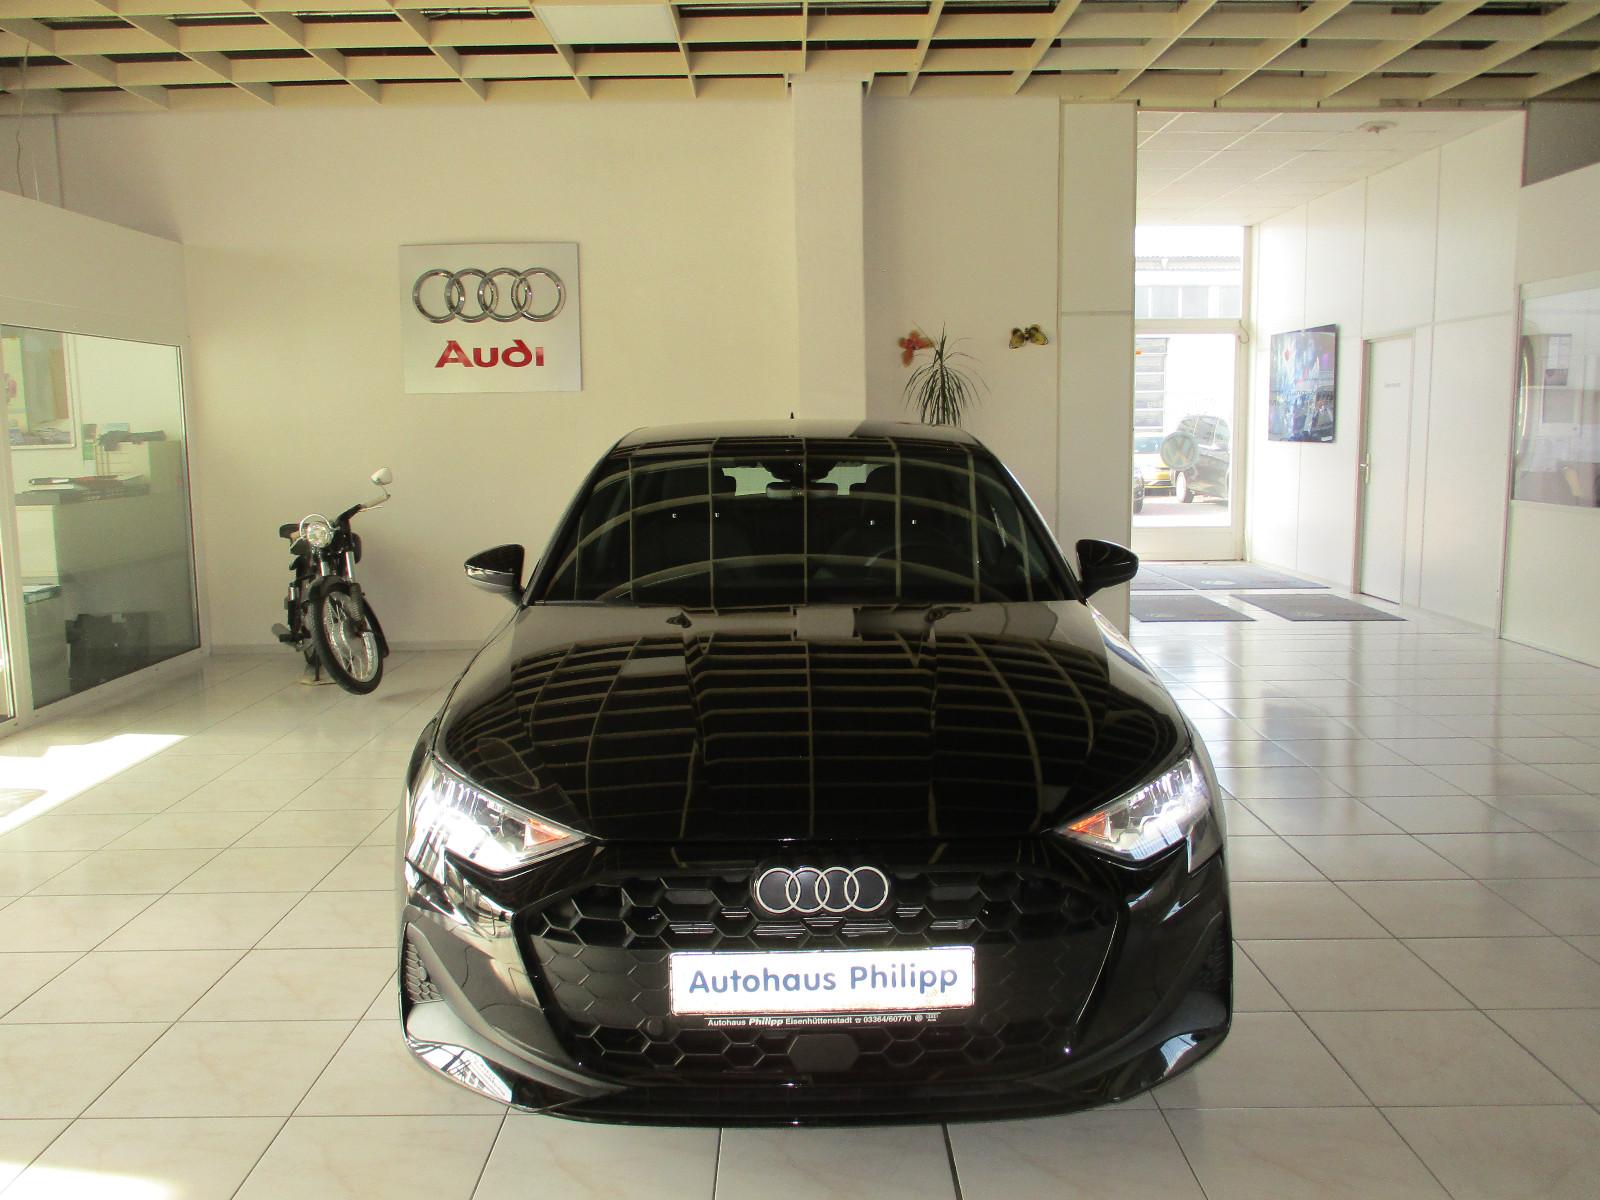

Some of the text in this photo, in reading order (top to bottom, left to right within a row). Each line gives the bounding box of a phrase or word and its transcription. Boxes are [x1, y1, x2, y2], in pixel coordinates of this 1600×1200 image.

[434, 339, 545, 368] Audi
[689, 963, 958, 994] Autohaus Philipp
[707, 1018, 746, 1026] Autohaus
[748, 1016, 784, 1026] Philipp
[785, 1016, 852, 1025] Eisenhüttenstadt
